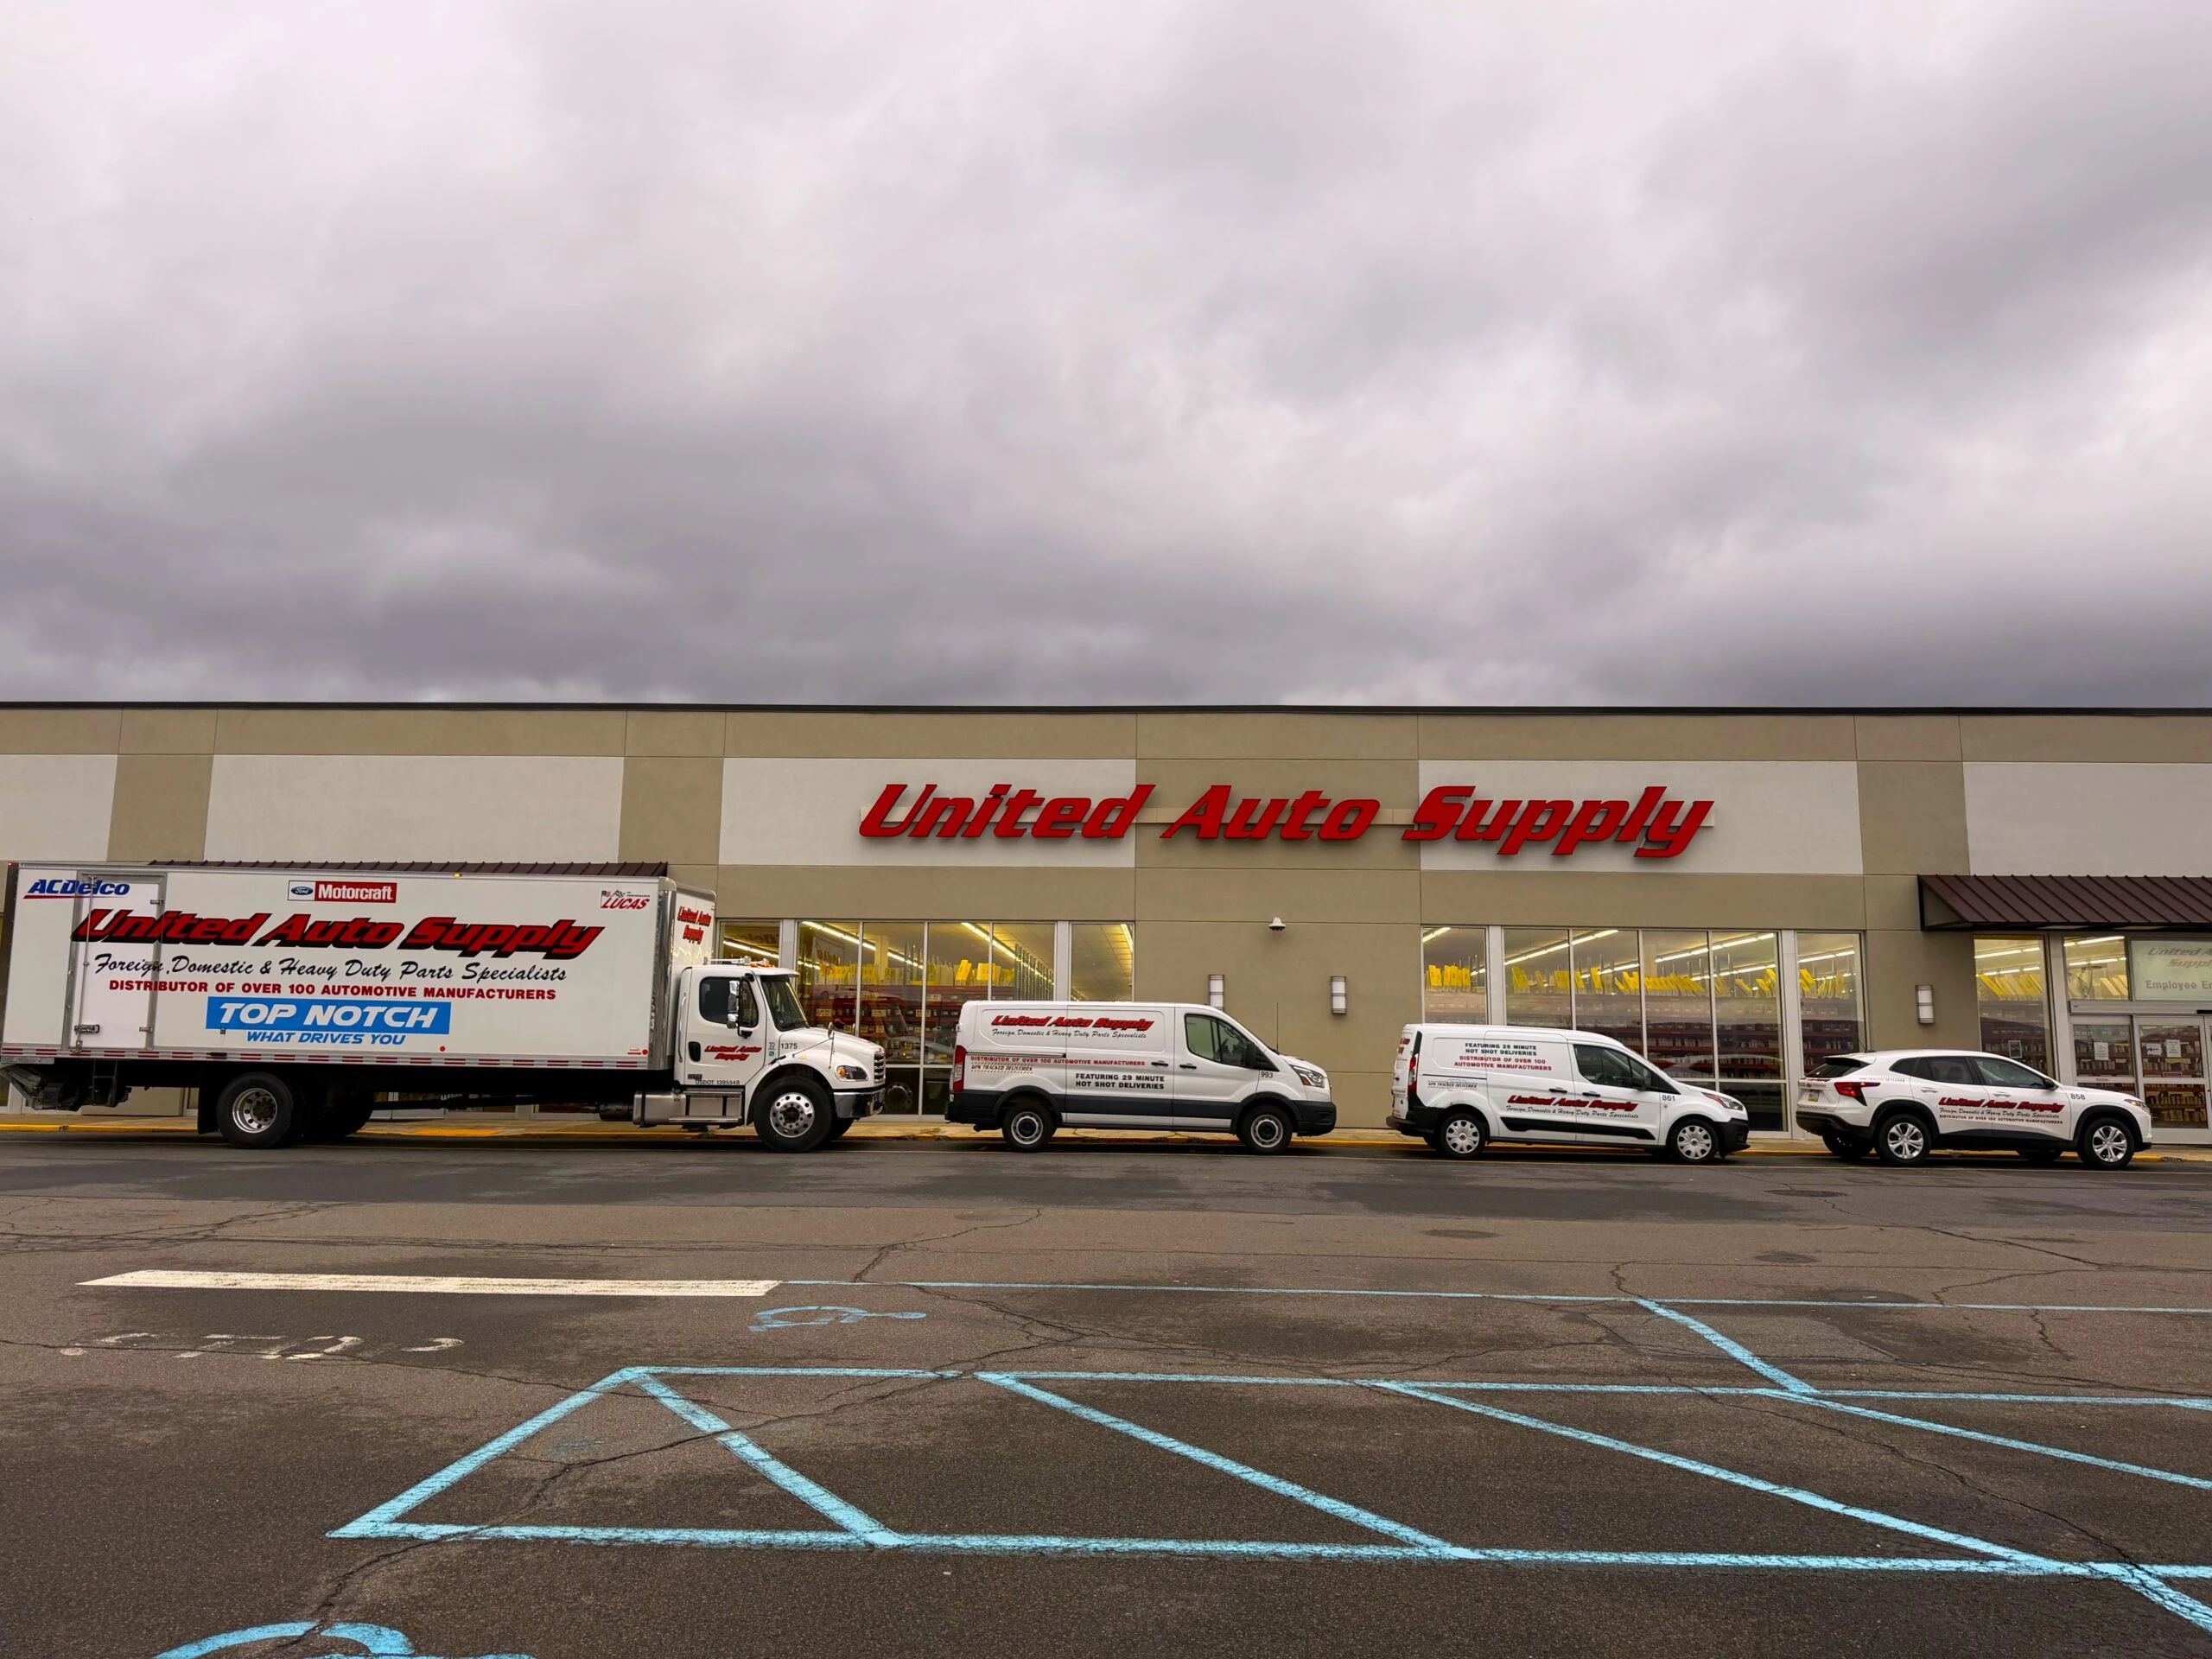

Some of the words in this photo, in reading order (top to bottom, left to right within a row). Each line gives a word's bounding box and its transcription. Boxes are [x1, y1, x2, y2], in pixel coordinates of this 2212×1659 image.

[859, 783, 1156, 840] United
[1159, 784, 1382, 841] Auto
[1402, 785, 1715, 858] Supply
[28, 879, 130, 896] ACDelco
[318, 884, 393, 900] Motorcraft
[601, 898, 651, 910] LUCAS
[677, 906, 698, 924] United
[71, 908, 271, 947] United
[251, 913, 404, 950] Auto
[397, 917, 605, 960] Supply
[2147, 947, 2202, 956] United
[259, 960, 271, 975] &
[278, 957, 338, 980] Heavy
[345, 959, 391, 982] Duty
[399, 960, 454, 980] Parts
[461, 963, 567, 983] Specialists
[109, 980, 208, 992] DISTRIBUTOR
[215, 982, 235, 993] OF
[242, 983, 282, 994] OVER
[289, 984, 315, 995] 100
[321, 985, 416, 997] AUTOMOTIVE
[423, 987, 556, 1000] MANUFACTURERS
[2145, 980, 2197, 990] Employee
[214, 1002, 296, 1025] TOP
[303, 1004, 438, 1028] NOTCH
[991, 1015, 1052, 1027] United
[1048, 1016, 1093, 1027] Auto
[1092, 1018, 1154, 1031] Supply
[246, 1031, 297, 1043] WHAT
[298, 1033, 364, 1045] DRIVES
[370, 1034, 406, 1046] YOU
[1507, 1095, 1556, 1105] United
[1553, 1097, 1590, 1107] Auto
[1588, 1099, 1638, 1111] Supply
[1938, 1097, 1985, 1107] United
[1982, 1099, 2018, 1109] Auto
[2017, 1101, 2065, 1113] Supply
